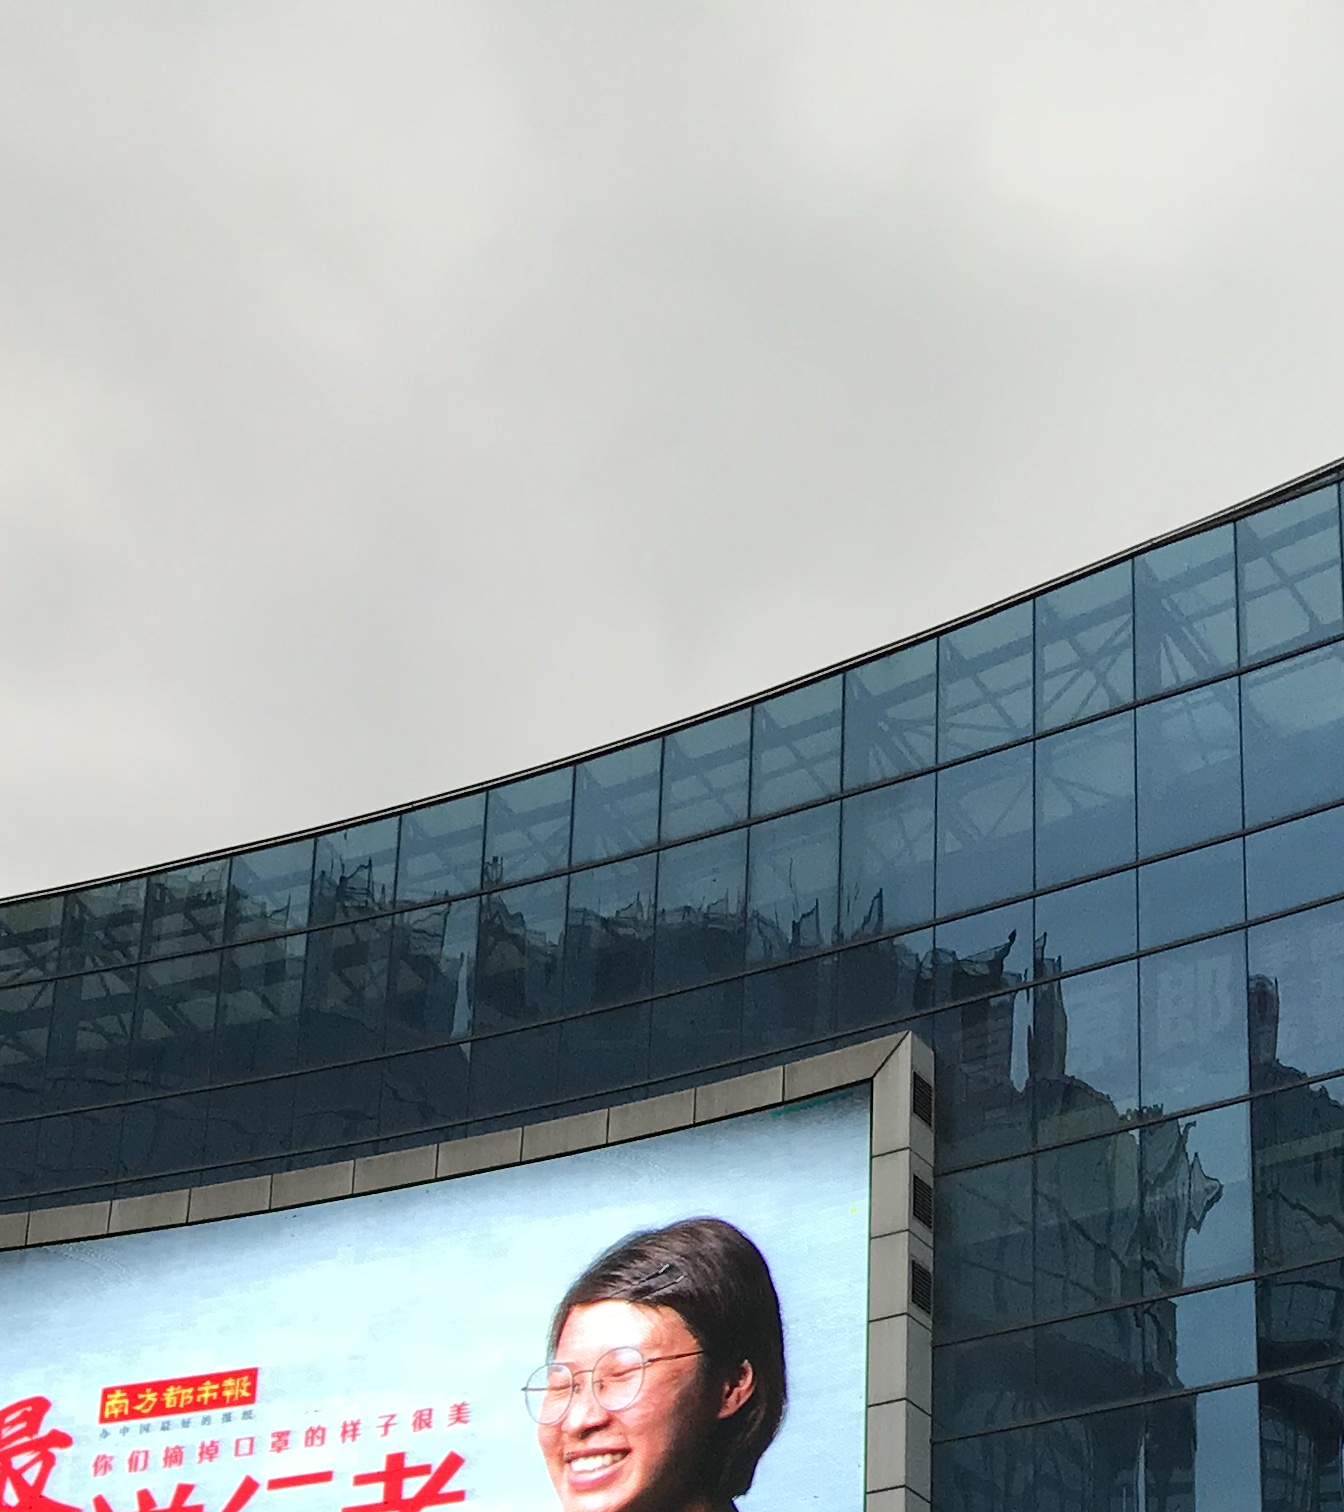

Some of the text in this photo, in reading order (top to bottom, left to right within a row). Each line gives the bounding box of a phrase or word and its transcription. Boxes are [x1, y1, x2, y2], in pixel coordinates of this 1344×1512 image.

[103, 1375, 252, 1419] 南方都市報
[91, 1400, 474, 1478] 你们摘掉口罩的样子很美
